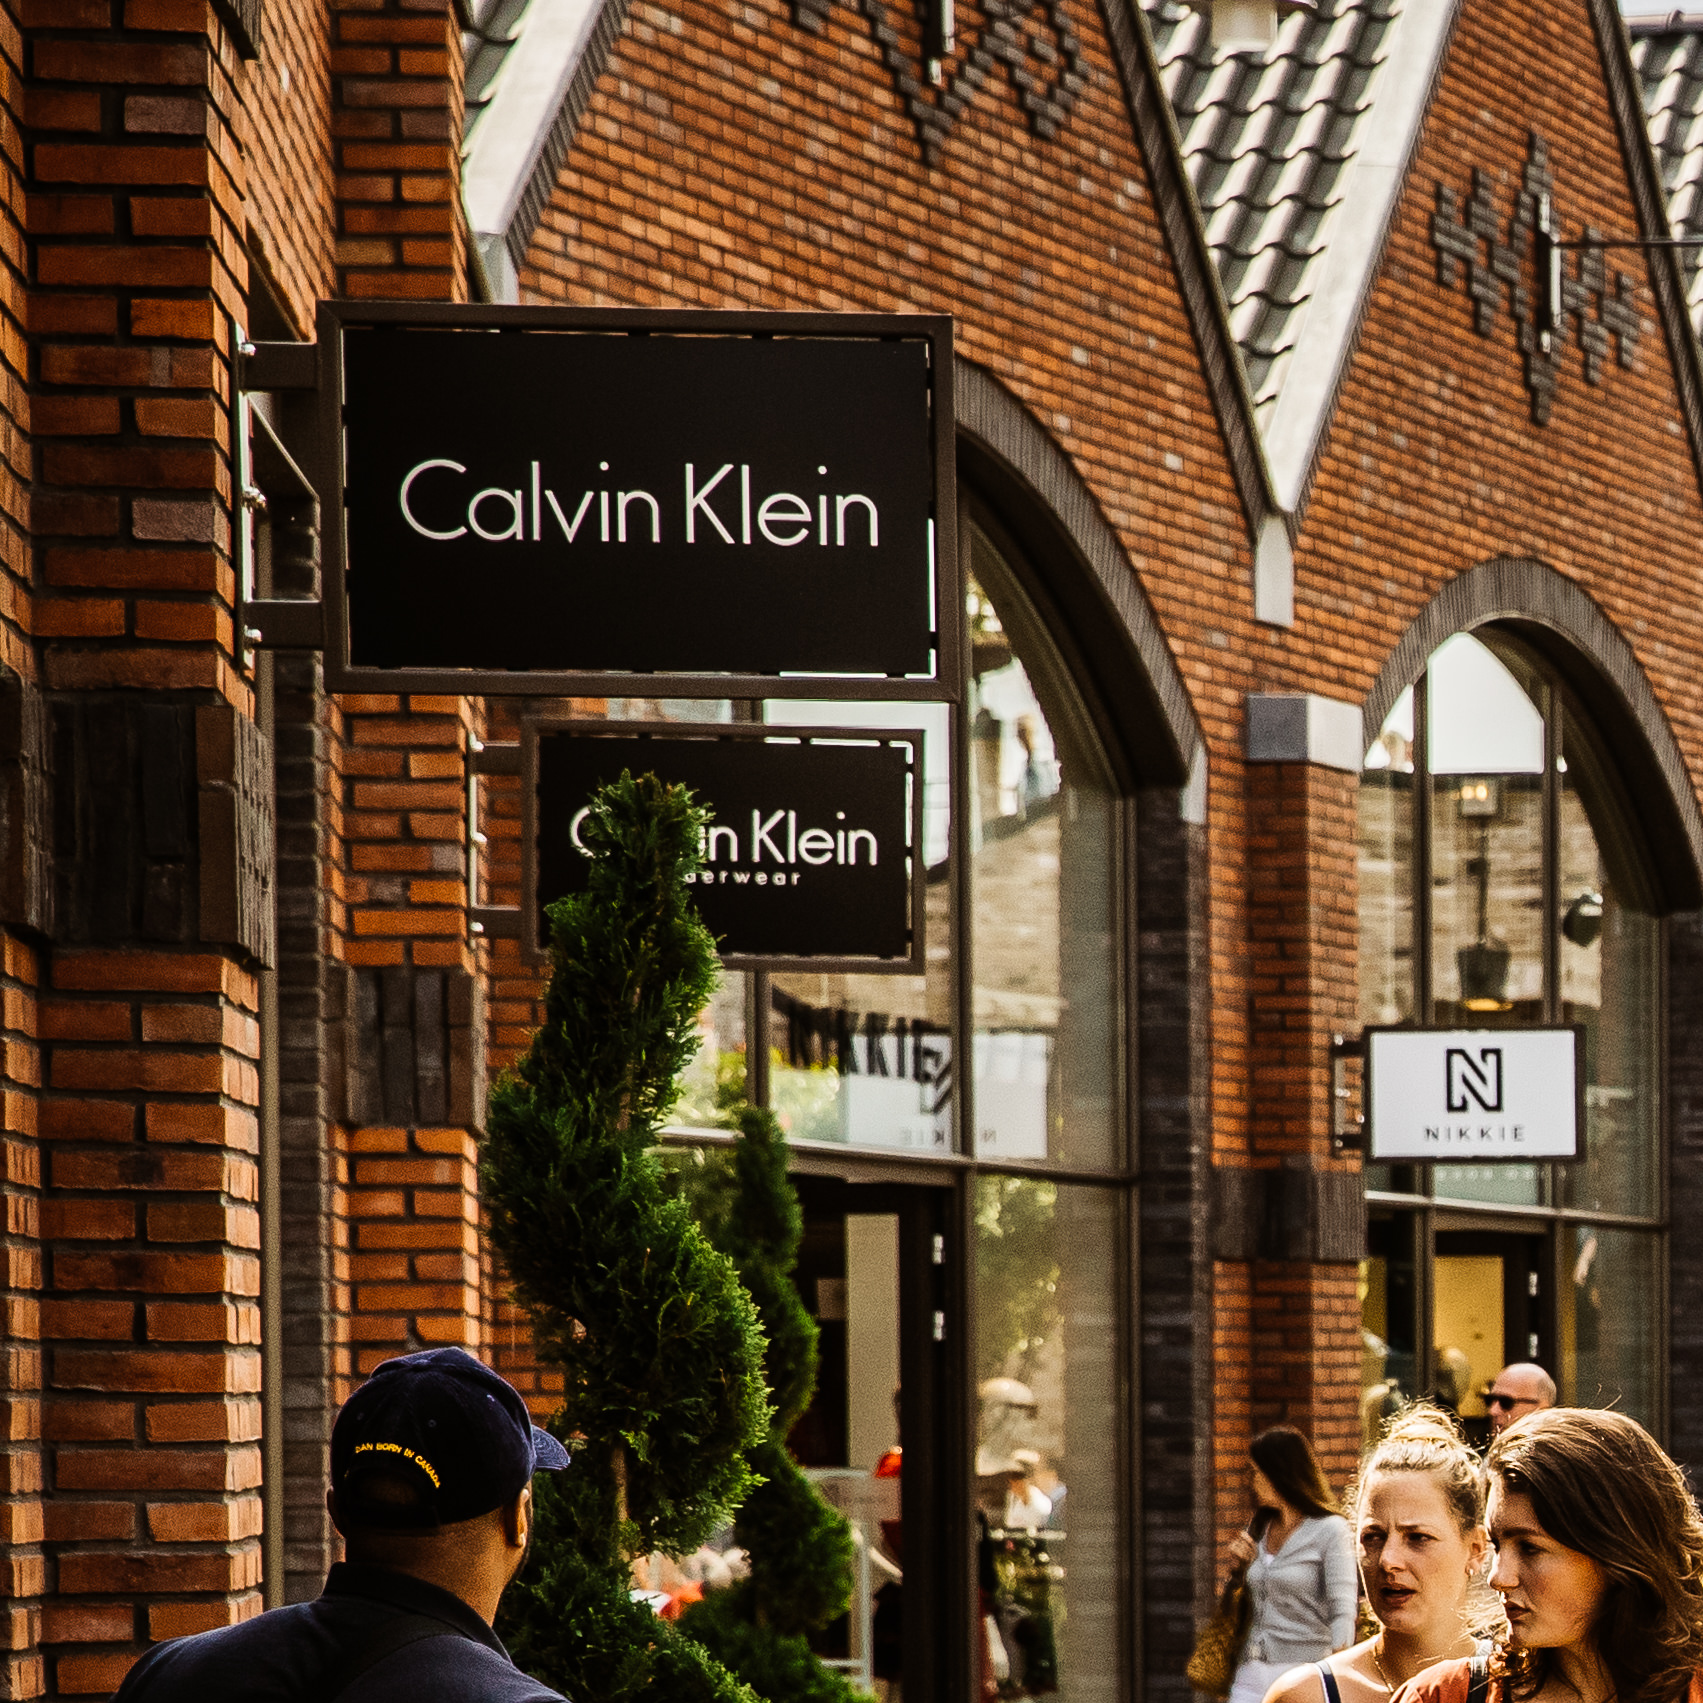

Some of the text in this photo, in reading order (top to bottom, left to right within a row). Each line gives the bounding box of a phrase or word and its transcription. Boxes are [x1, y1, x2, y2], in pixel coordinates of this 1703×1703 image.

[400, 458, 879, 547] Calvin Klein
[751, 808, 879, 866] Klein
[1424, 1126, 1526, 1142] NIKKIE
[376, 1442, 402, 1453] BORN
[415, 1455, 441, 1488] CANADA
